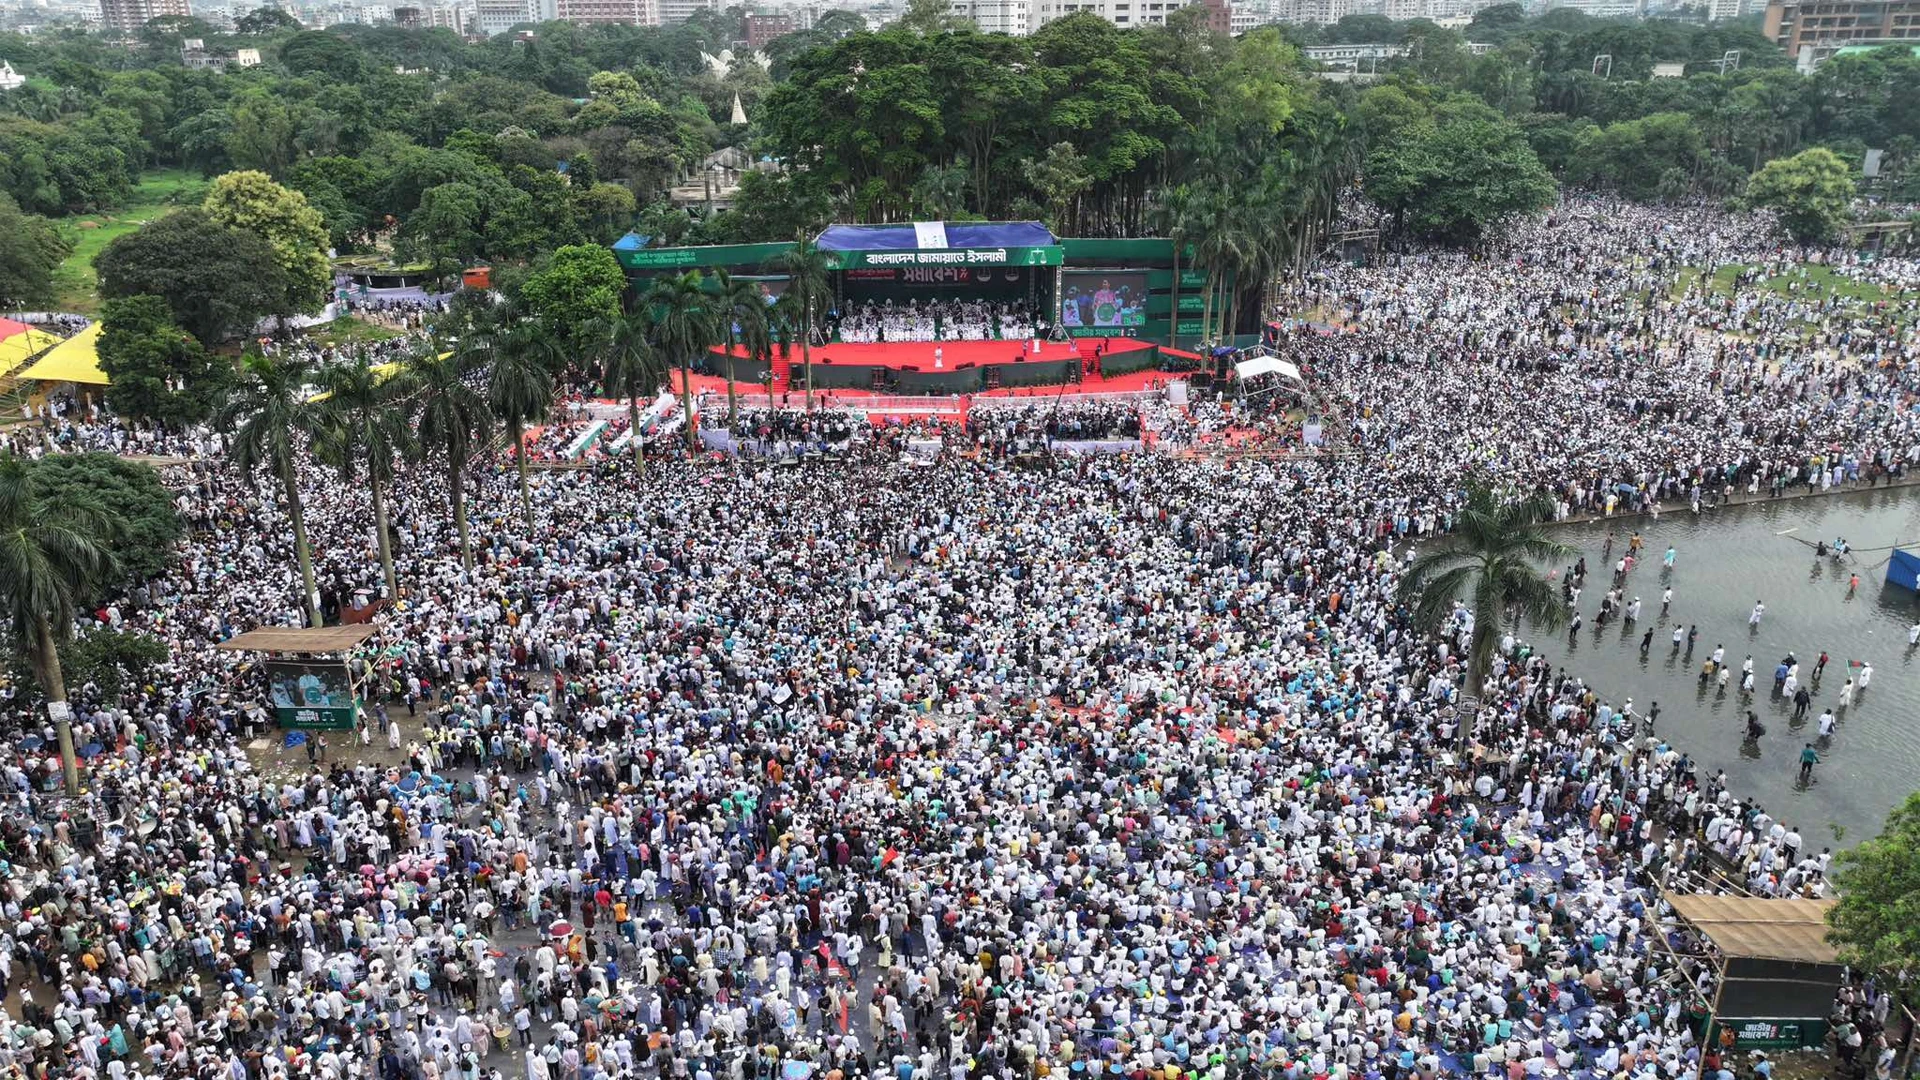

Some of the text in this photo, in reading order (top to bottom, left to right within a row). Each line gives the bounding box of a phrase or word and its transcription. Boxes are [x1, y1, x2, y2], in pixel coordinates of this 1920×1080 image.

[866, 249, 1007, 264] বাংলাদেশ জামায়াতে ইসলামী
[1745, 1022, 1771, 1031] জাতীয়
[1738, 1031, 1770, 1039] সমাবেশ
